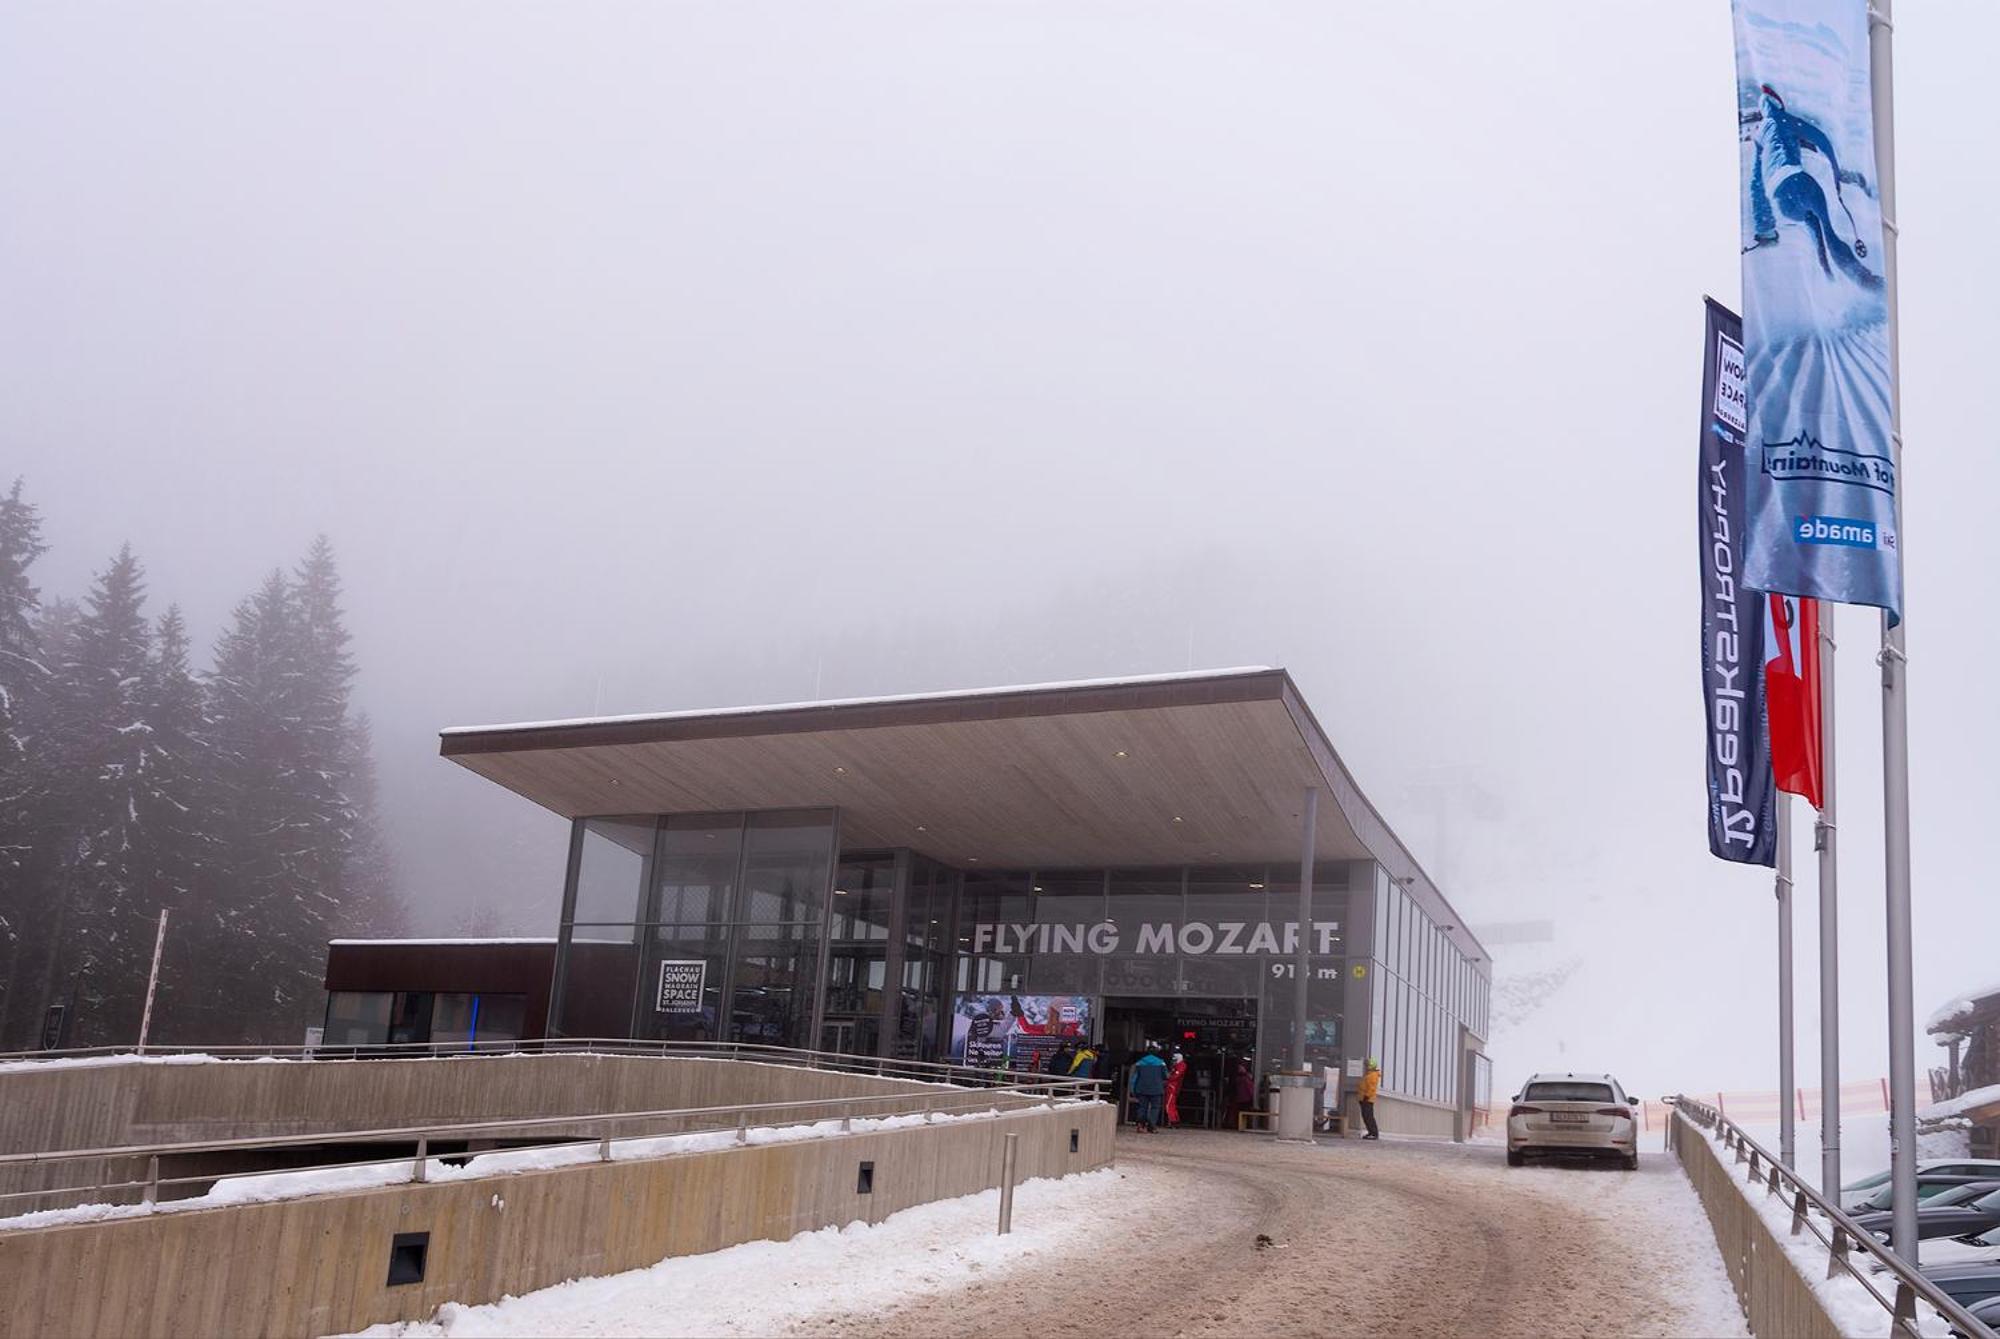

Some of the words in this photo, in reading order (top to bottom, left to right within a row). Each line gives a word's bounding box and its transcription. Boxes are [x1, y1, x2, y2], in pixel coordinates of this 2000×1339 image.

[973, 923, 1120, 954] FLYING
[1136, 922, 1339, 954] MOZART
[665, 973, 700, 982] SNOW
[1318, 968, 1336, 979] m
[663, 990, 698, 999] SPACE
